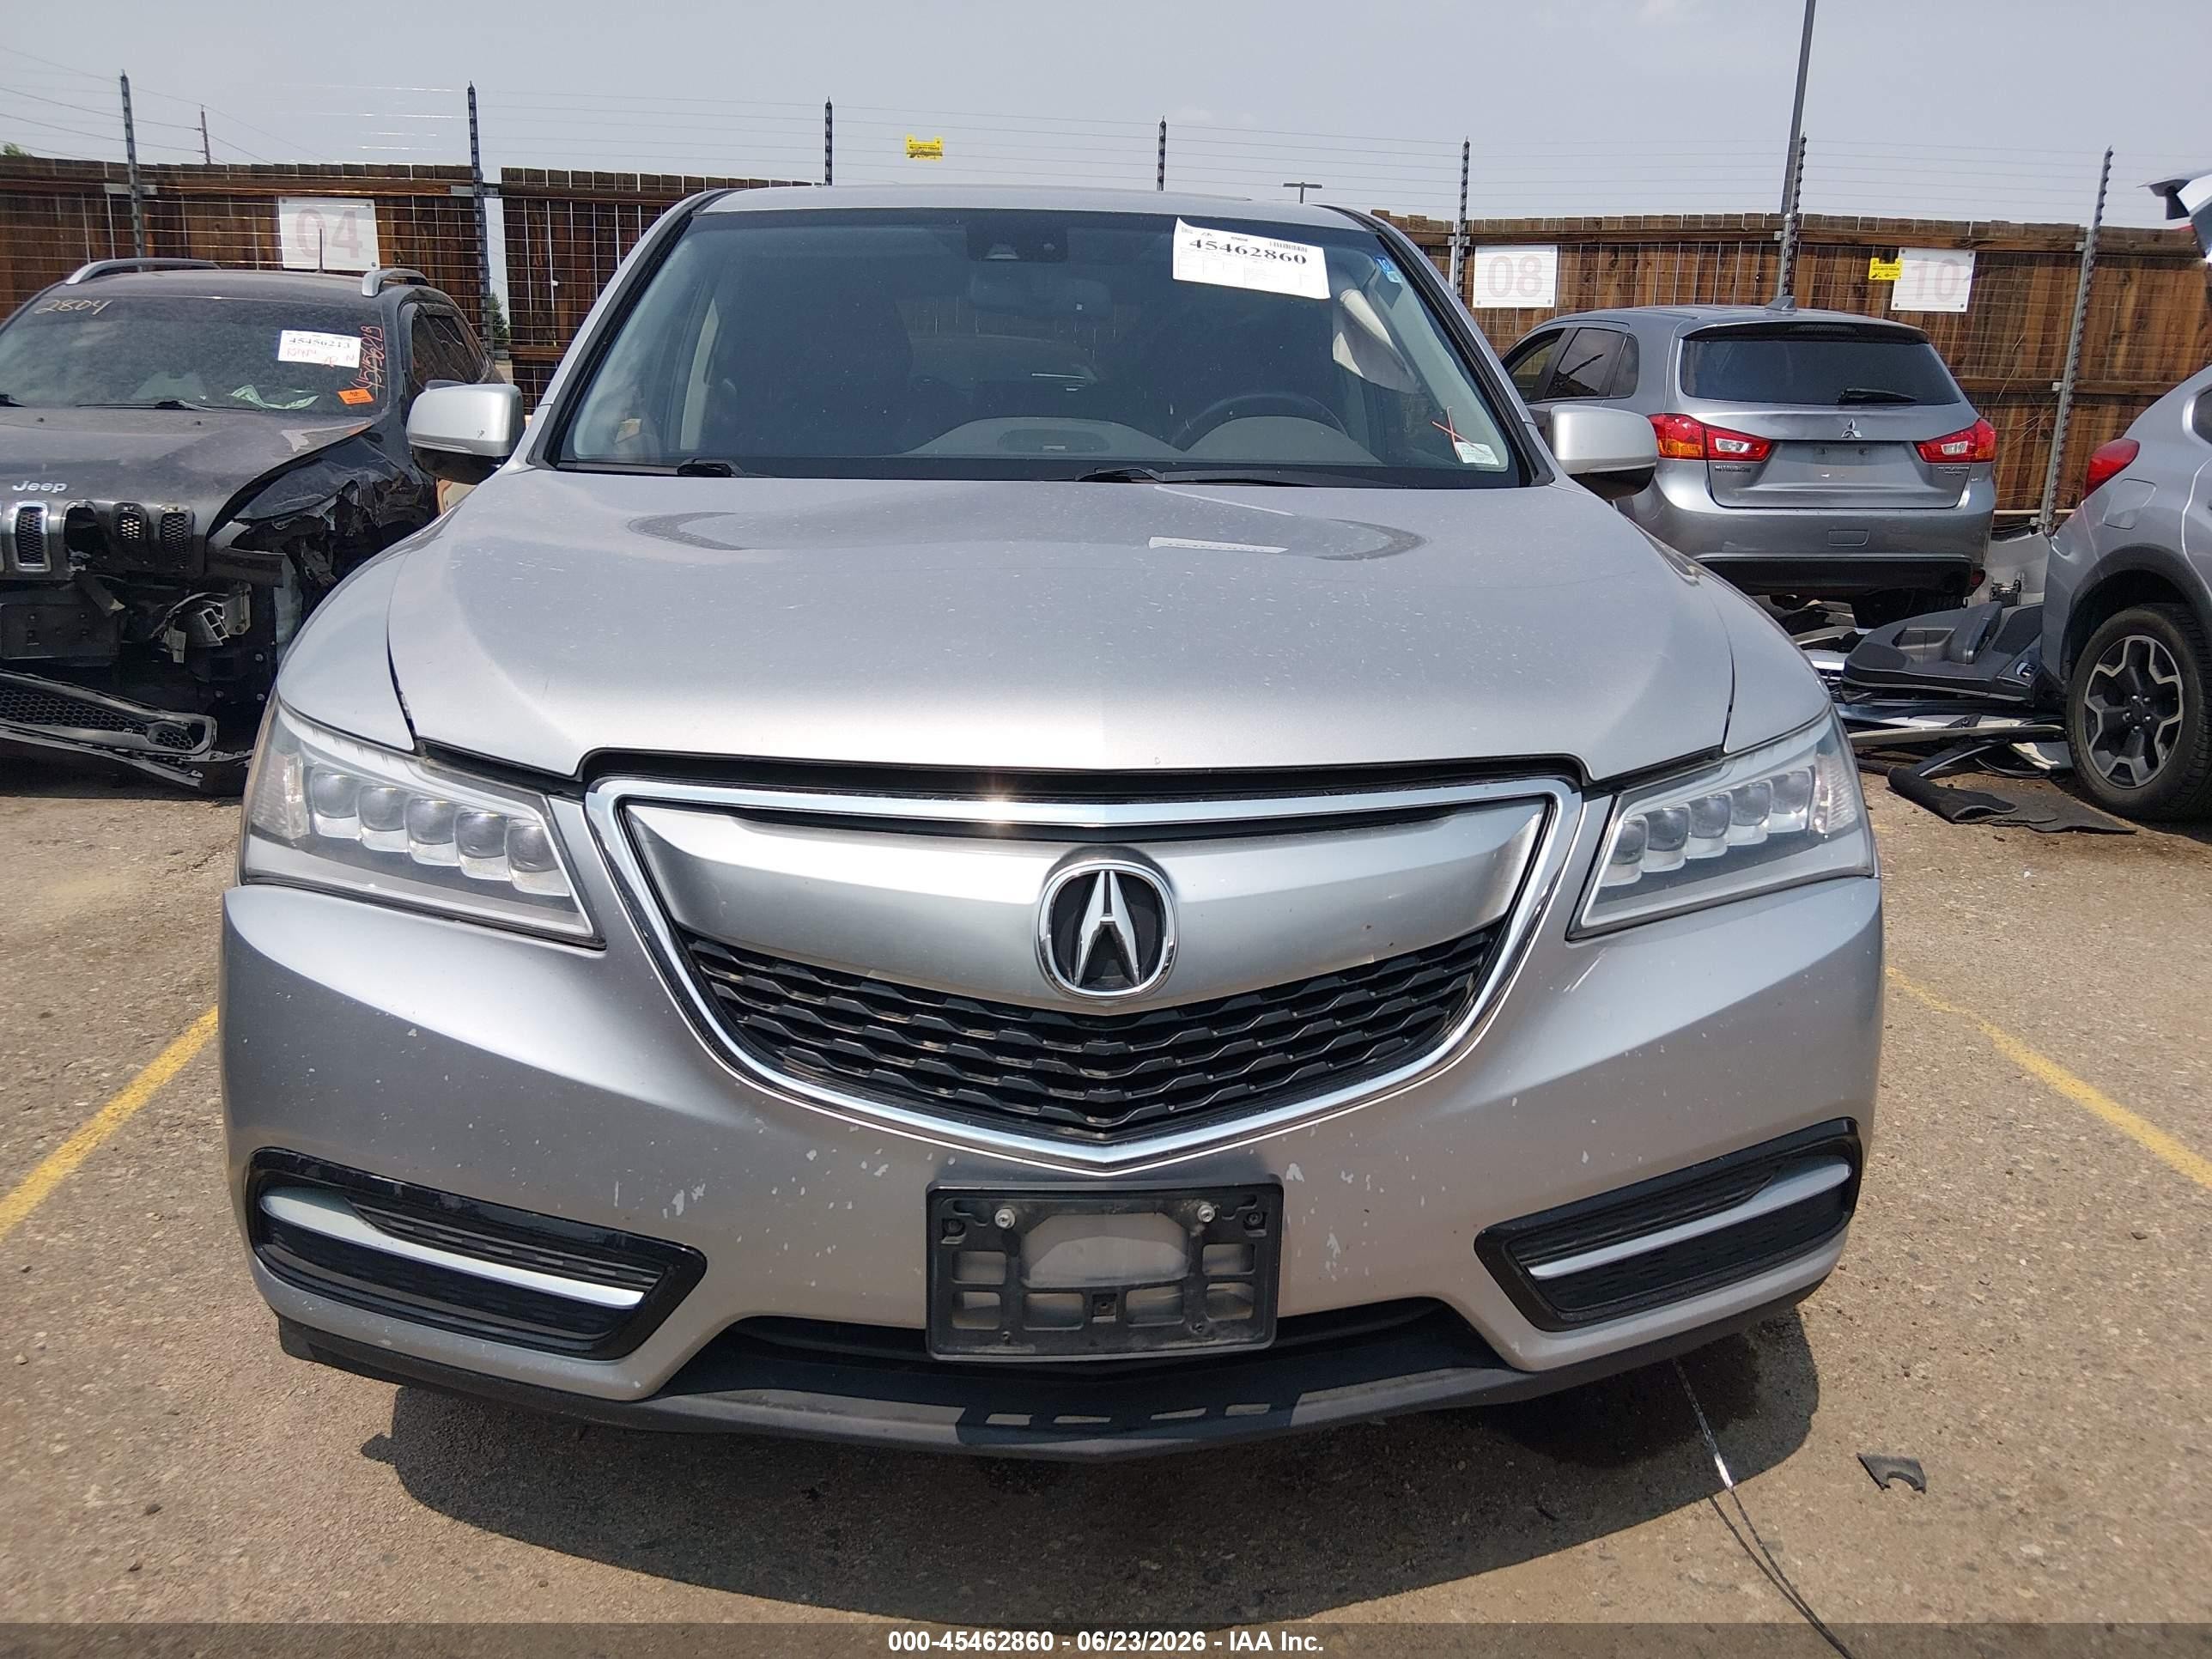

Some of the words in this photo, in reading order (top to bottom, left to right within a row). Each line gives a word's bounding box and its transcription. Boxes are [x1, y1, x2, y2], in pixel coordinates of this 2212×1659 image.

[296, 209, 362, 258] 04
[1189, 239, 1307, 264] 45462860
[1488, 255, 1542, 298] 08
[1910, 258, 1961, 302] 10
[34, 299, 113, 316] 2804
[12, 480, 68, 494] Jeep
